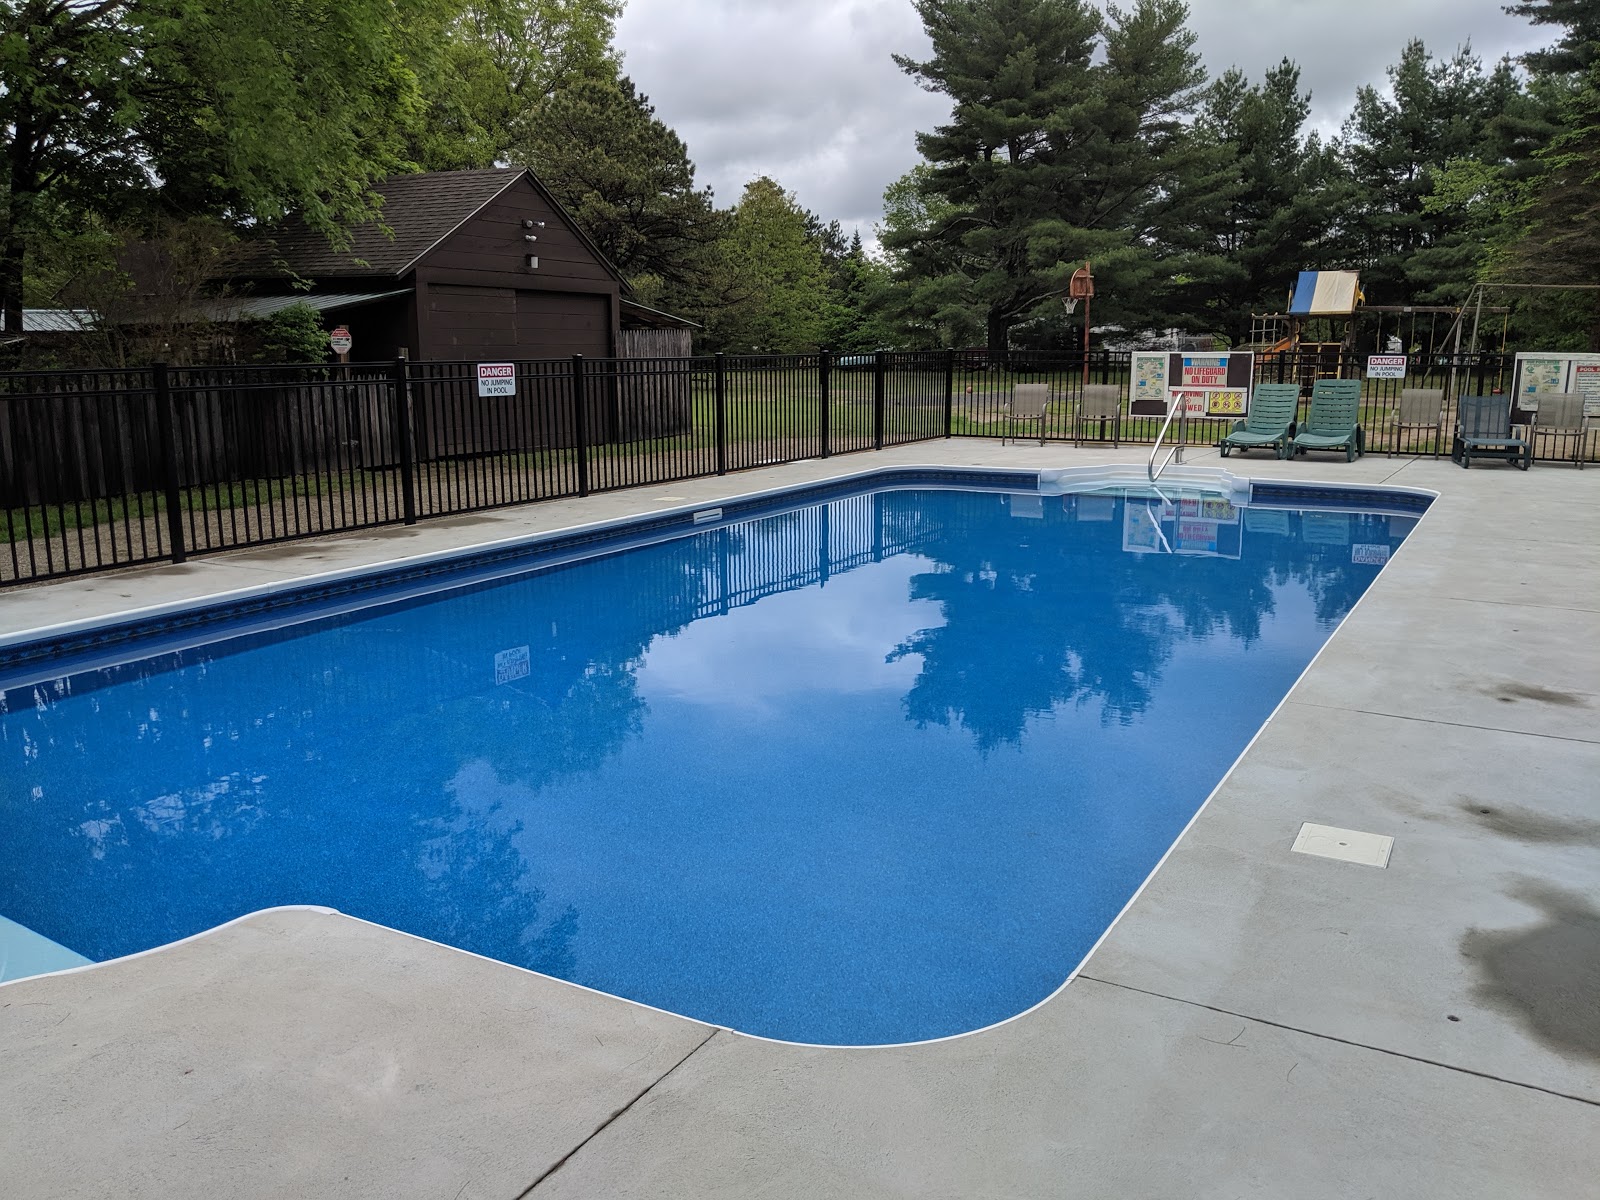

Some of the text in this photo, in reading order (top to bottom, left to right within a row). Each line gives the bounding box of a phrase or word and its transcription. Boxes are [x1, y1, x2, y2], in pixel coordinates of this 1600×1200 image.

[481, 367, 512, 376] DANGER
[1185, 367, 1226, 376] NO LIFEGUARD
[1191, 376, 1218, 384] ON DUTY
[1173, 404, 1202, 412] LLWED
